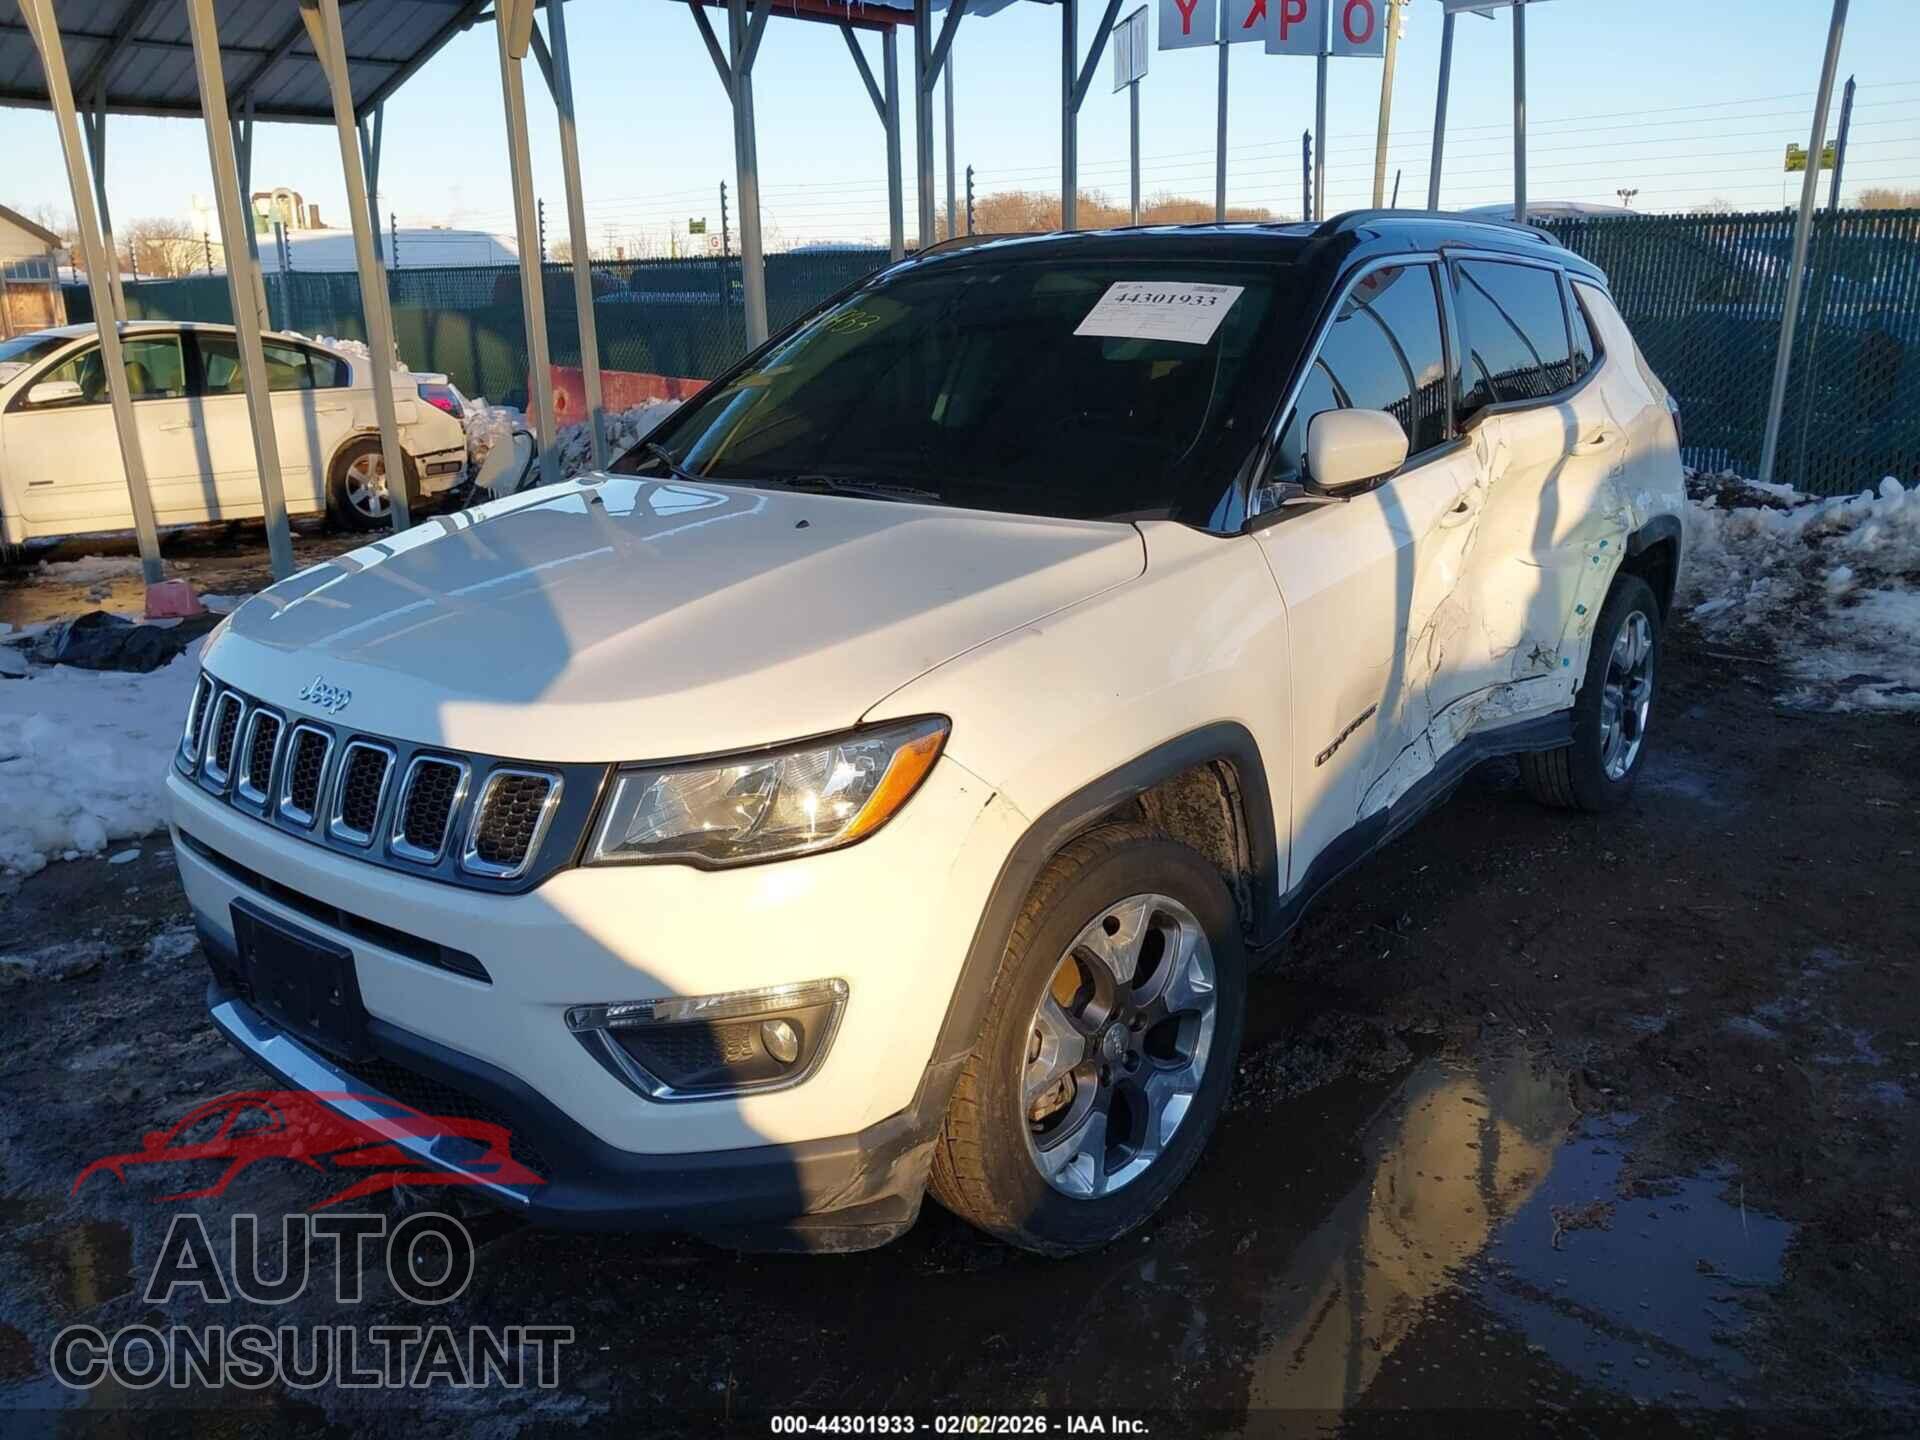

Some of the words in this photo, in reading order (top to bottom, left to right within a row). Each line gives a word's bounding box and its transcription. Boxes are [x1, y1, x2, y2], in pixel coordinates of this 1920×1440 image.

[1174, 0, 1199, 35] Y
[1280, 0, 1307, 41] P
[1115, 292, 1218, 307] 44301933
[299, 674, 352, 716] Jeep
